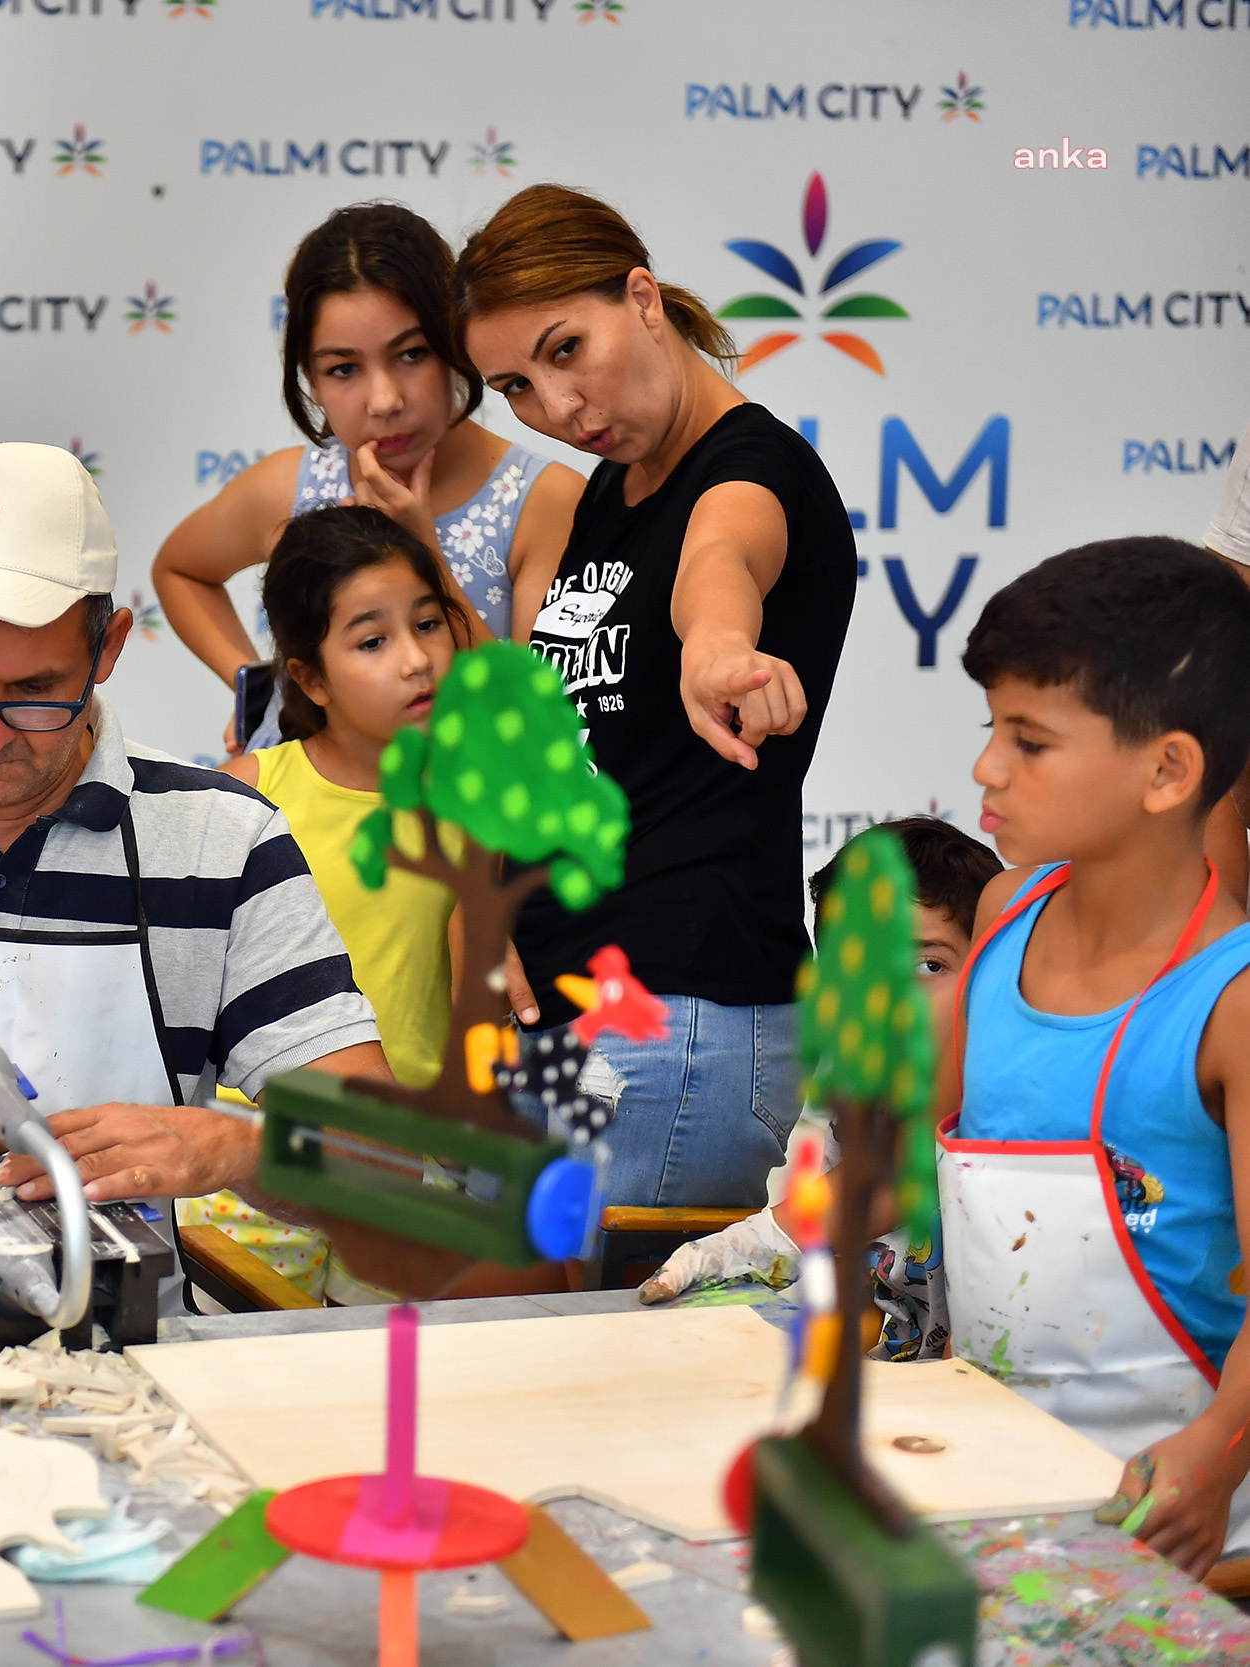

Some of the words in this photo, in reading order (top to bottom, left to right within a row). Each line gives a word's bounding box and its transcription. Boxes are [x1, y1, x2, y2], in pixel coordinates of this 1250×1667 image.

[1069, 0, 1187, 29] PALM
[685, 83, 807, 119] PALM
[817, 83, 923, 121] CITY
[201, 139, 329, 176] PALM
[338, 139, 450, 176] CITY
[1136, 143, 1250, 180] PALM
[1036, 291, 1154, 329] PALM
[1122, 438, 1238, 475] PALM
[598, 694, 625, 712] 1926
